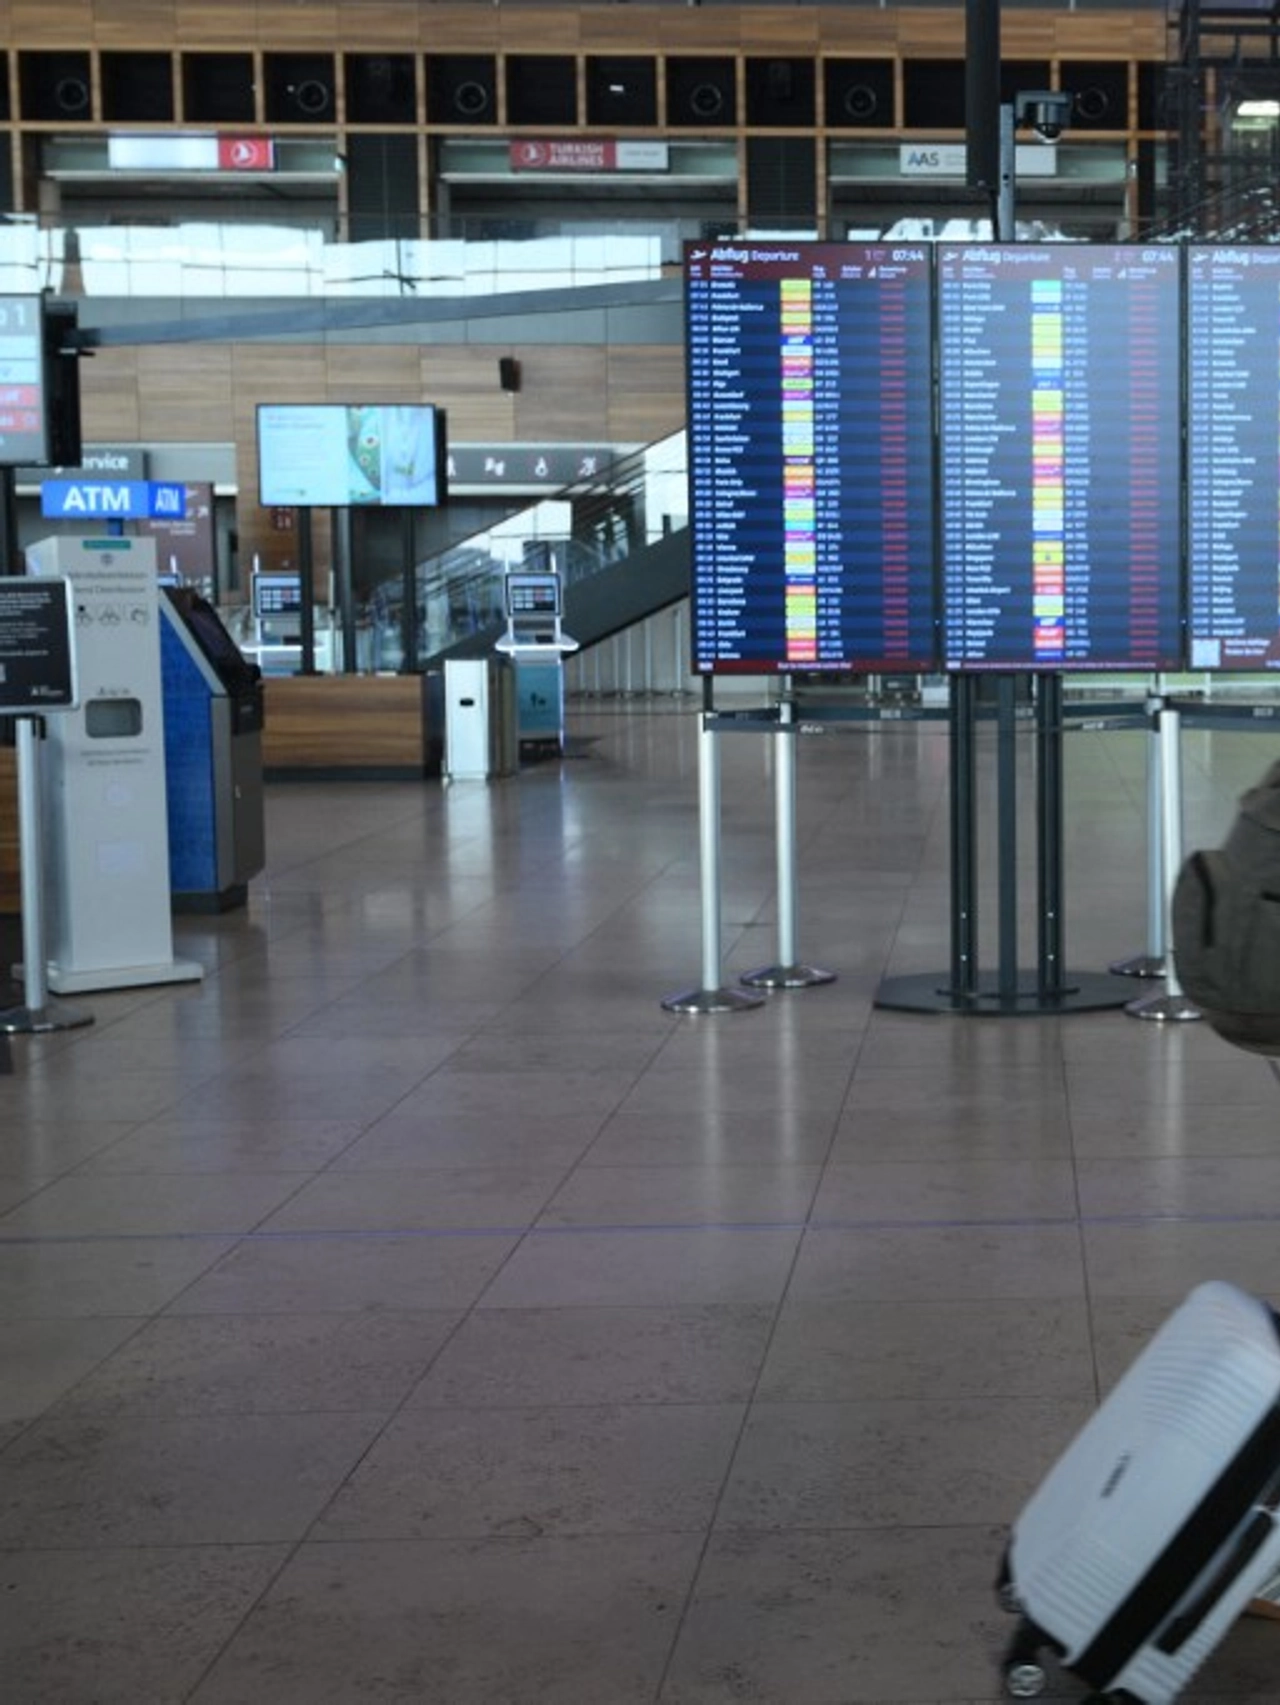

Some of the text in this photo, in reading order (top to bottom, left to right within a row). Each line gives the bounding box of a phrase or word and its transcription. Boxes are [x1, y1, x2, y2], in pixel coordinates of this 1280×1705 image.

[908, 152, 940, 167] AAS
[710, 248, 799, 263] Abflug Departure
[962, 249, 1050, 264] Abflug Departure
[1212, 250, 1249, 265] Abflug
[63, 486, 130, 511] ATM
[155, 487, 180, 512] ATM
